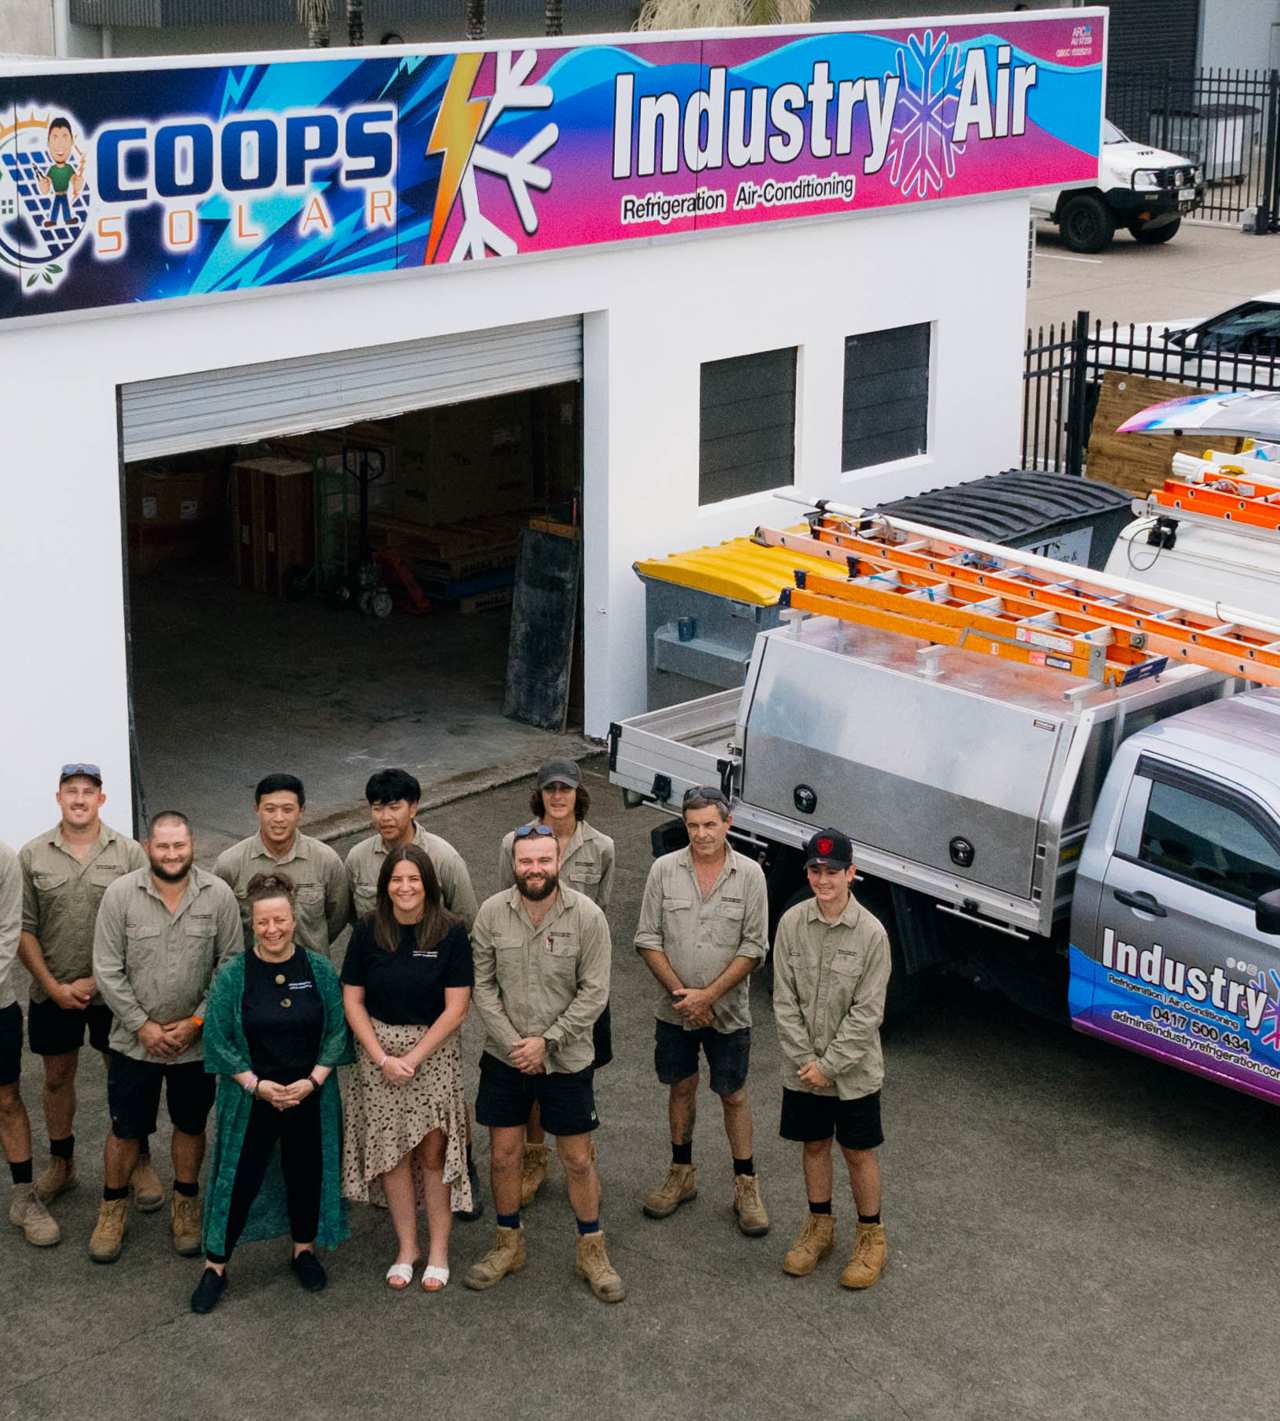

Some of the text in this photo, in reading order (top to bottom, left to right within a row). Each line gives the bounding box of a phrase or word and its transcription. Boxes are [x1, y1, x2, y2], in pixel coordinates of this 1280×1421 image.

[612, 45, 1036, 179] Industry Air
[96, 111, 393, 203] COOPS
[98, 190, 392, 253] SOLAR
[623, 174, 854, 222] Refrigeration Air-Conditioning
[1102, 927, 1268, 1029] Industry
[1109, 974, 1163, 1002] Refrigeration
[1152, 1005, 1250, 1053] 0417 500 434
